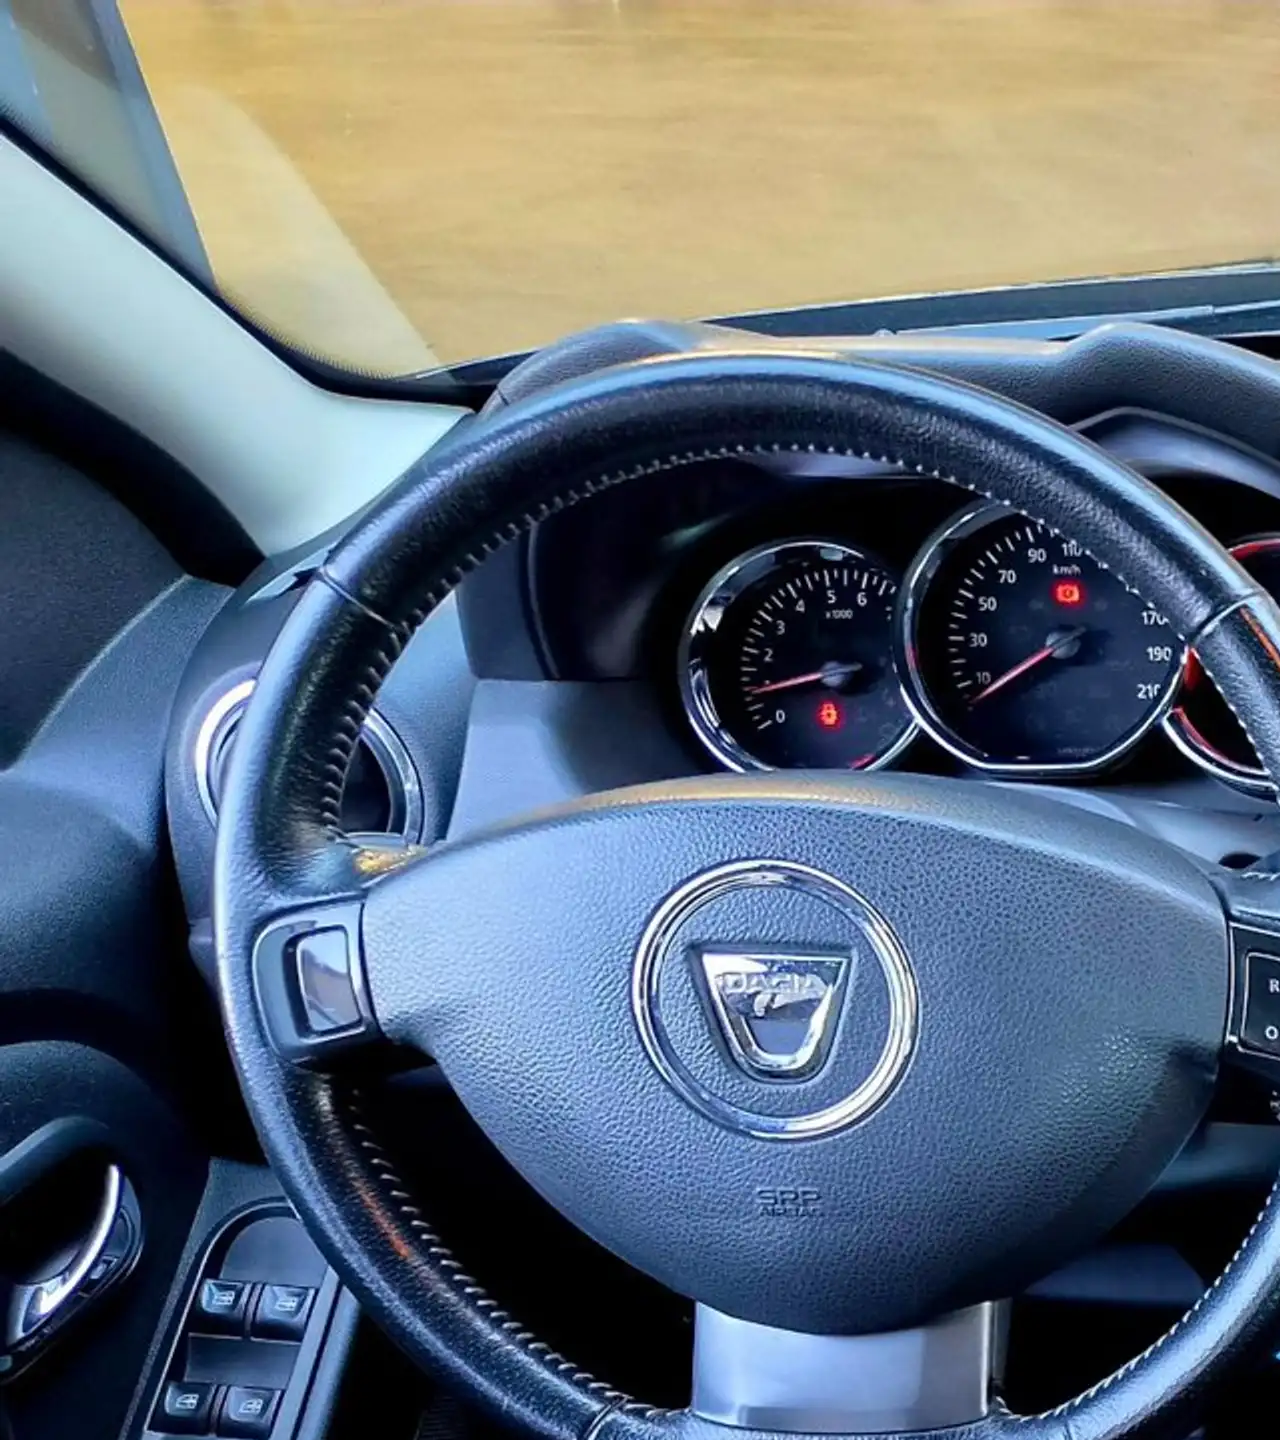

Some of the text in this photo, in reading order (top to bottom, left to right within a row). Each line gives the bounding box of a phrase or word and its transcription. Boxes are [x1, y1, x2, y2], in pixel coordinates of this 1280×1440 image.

[1028, 548, 1047, 563] 90
[998, 569, 1017, 584] 70
[1052, 564, 1081, 576] km/h
[826, 590, 837, 603] 5
[857, 592, 867, 606] 6
[978, 596, 997, 611] 50
[795, 599, 805, 612] 4
[776, 620, 785, 635] 3
[969, 632, 988, 647] 30
[763, 648, 773, 662] 2
[1146, 646, 1172, 661] 190
[976, 672, 991, 685] 10
[775, 709, 785, 723] 0
[1268, 978, 1280, 993] R
